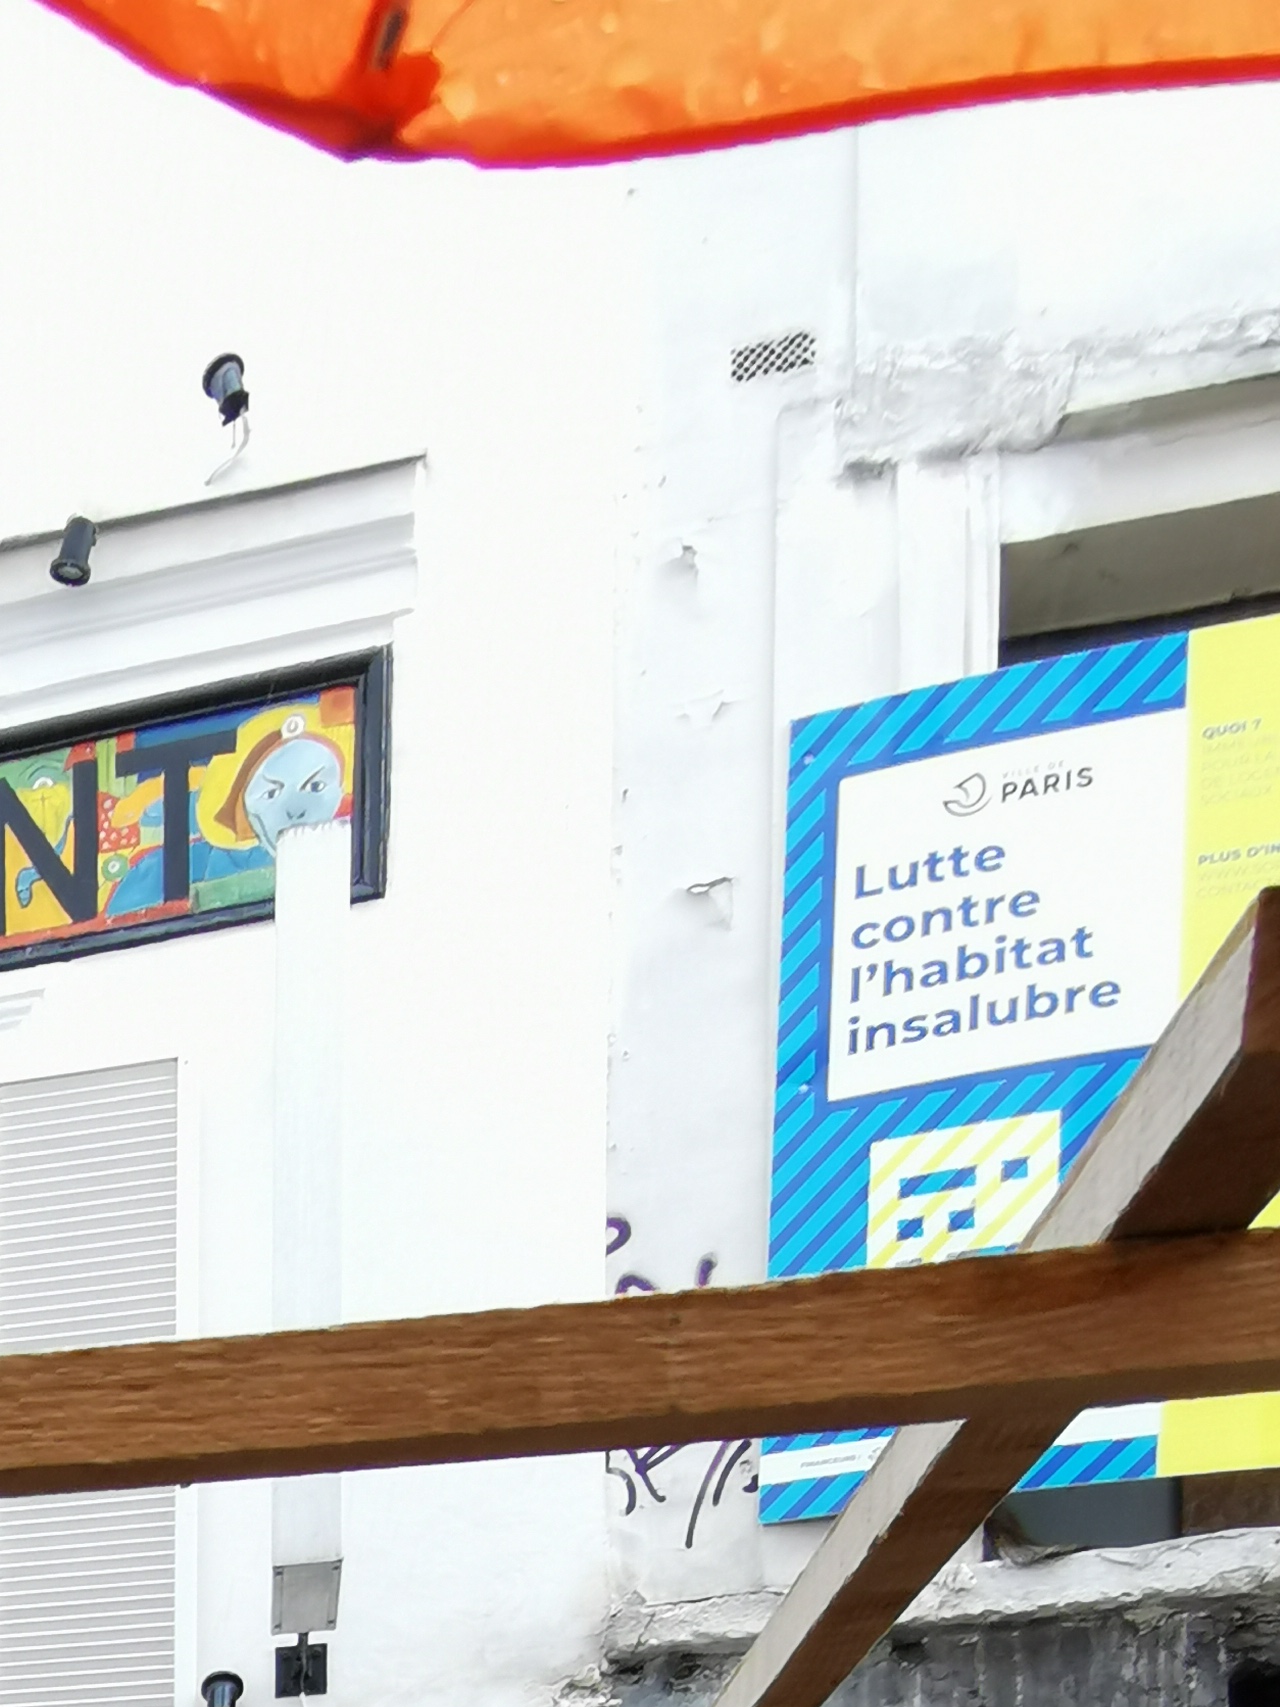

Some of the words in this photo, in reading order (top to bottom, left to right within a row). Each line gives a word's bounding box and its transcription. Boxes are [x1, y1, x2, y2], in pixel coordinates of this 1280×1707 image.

[1001, 766, 1094, 803] PARIS
[854, 844, 1006, 900] Lutte
[851, 890, 1040, 950] contre
[850, 926, 1094, 1003] l'habitat
[847, 980, 1121, 1056] insalubre
